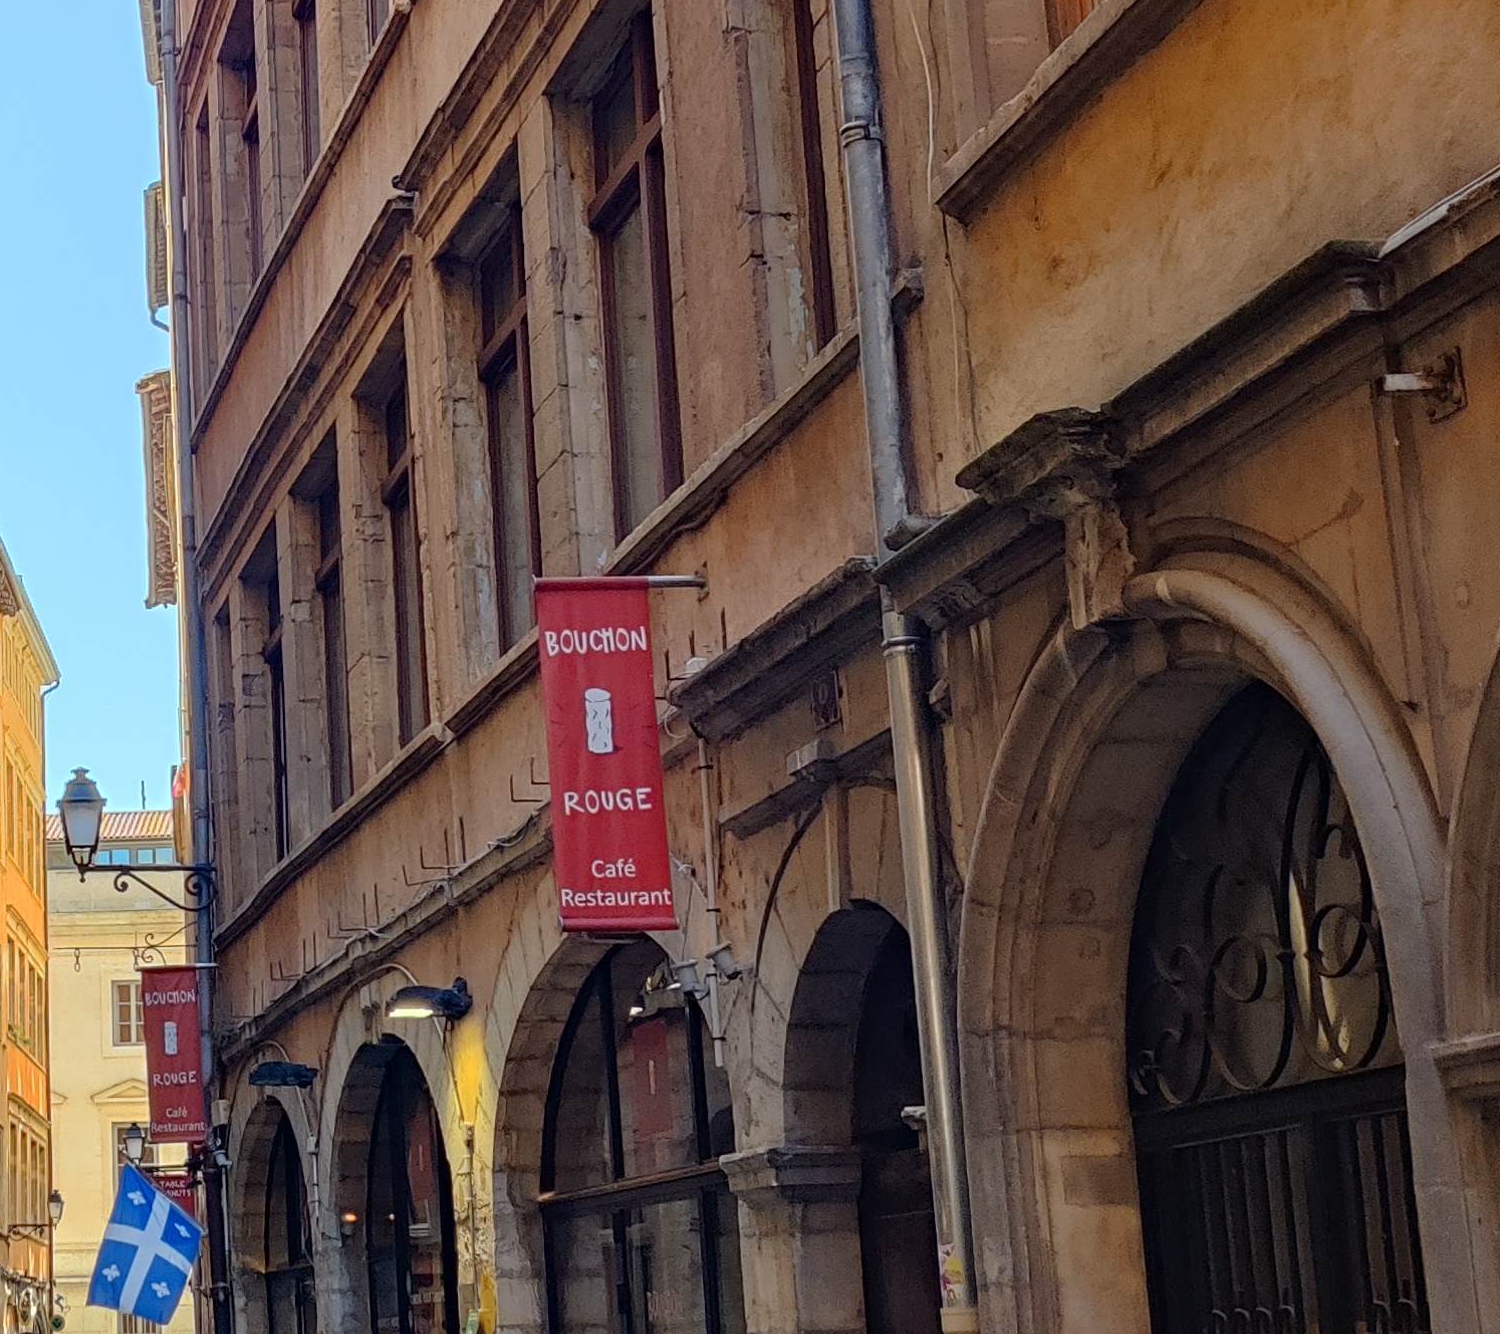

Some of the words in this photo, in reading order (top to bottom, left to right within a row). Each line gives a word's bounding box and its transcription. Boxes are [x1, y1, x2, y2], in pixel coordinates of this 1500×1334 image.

[544, 625, 647, 657] BOUCHON
[564, 787, 653, 815] ROUGE
[591, 857, 636, 879] Café
[561, 888, 672, 908] Restaurant
[144, 989, 196, 1006] BOUCHON
[153, 1070, 198, 1086] ROUGE
[165, 1105, 188, 1118] Café
[151, 1121, 206, 1133] Restaurant
